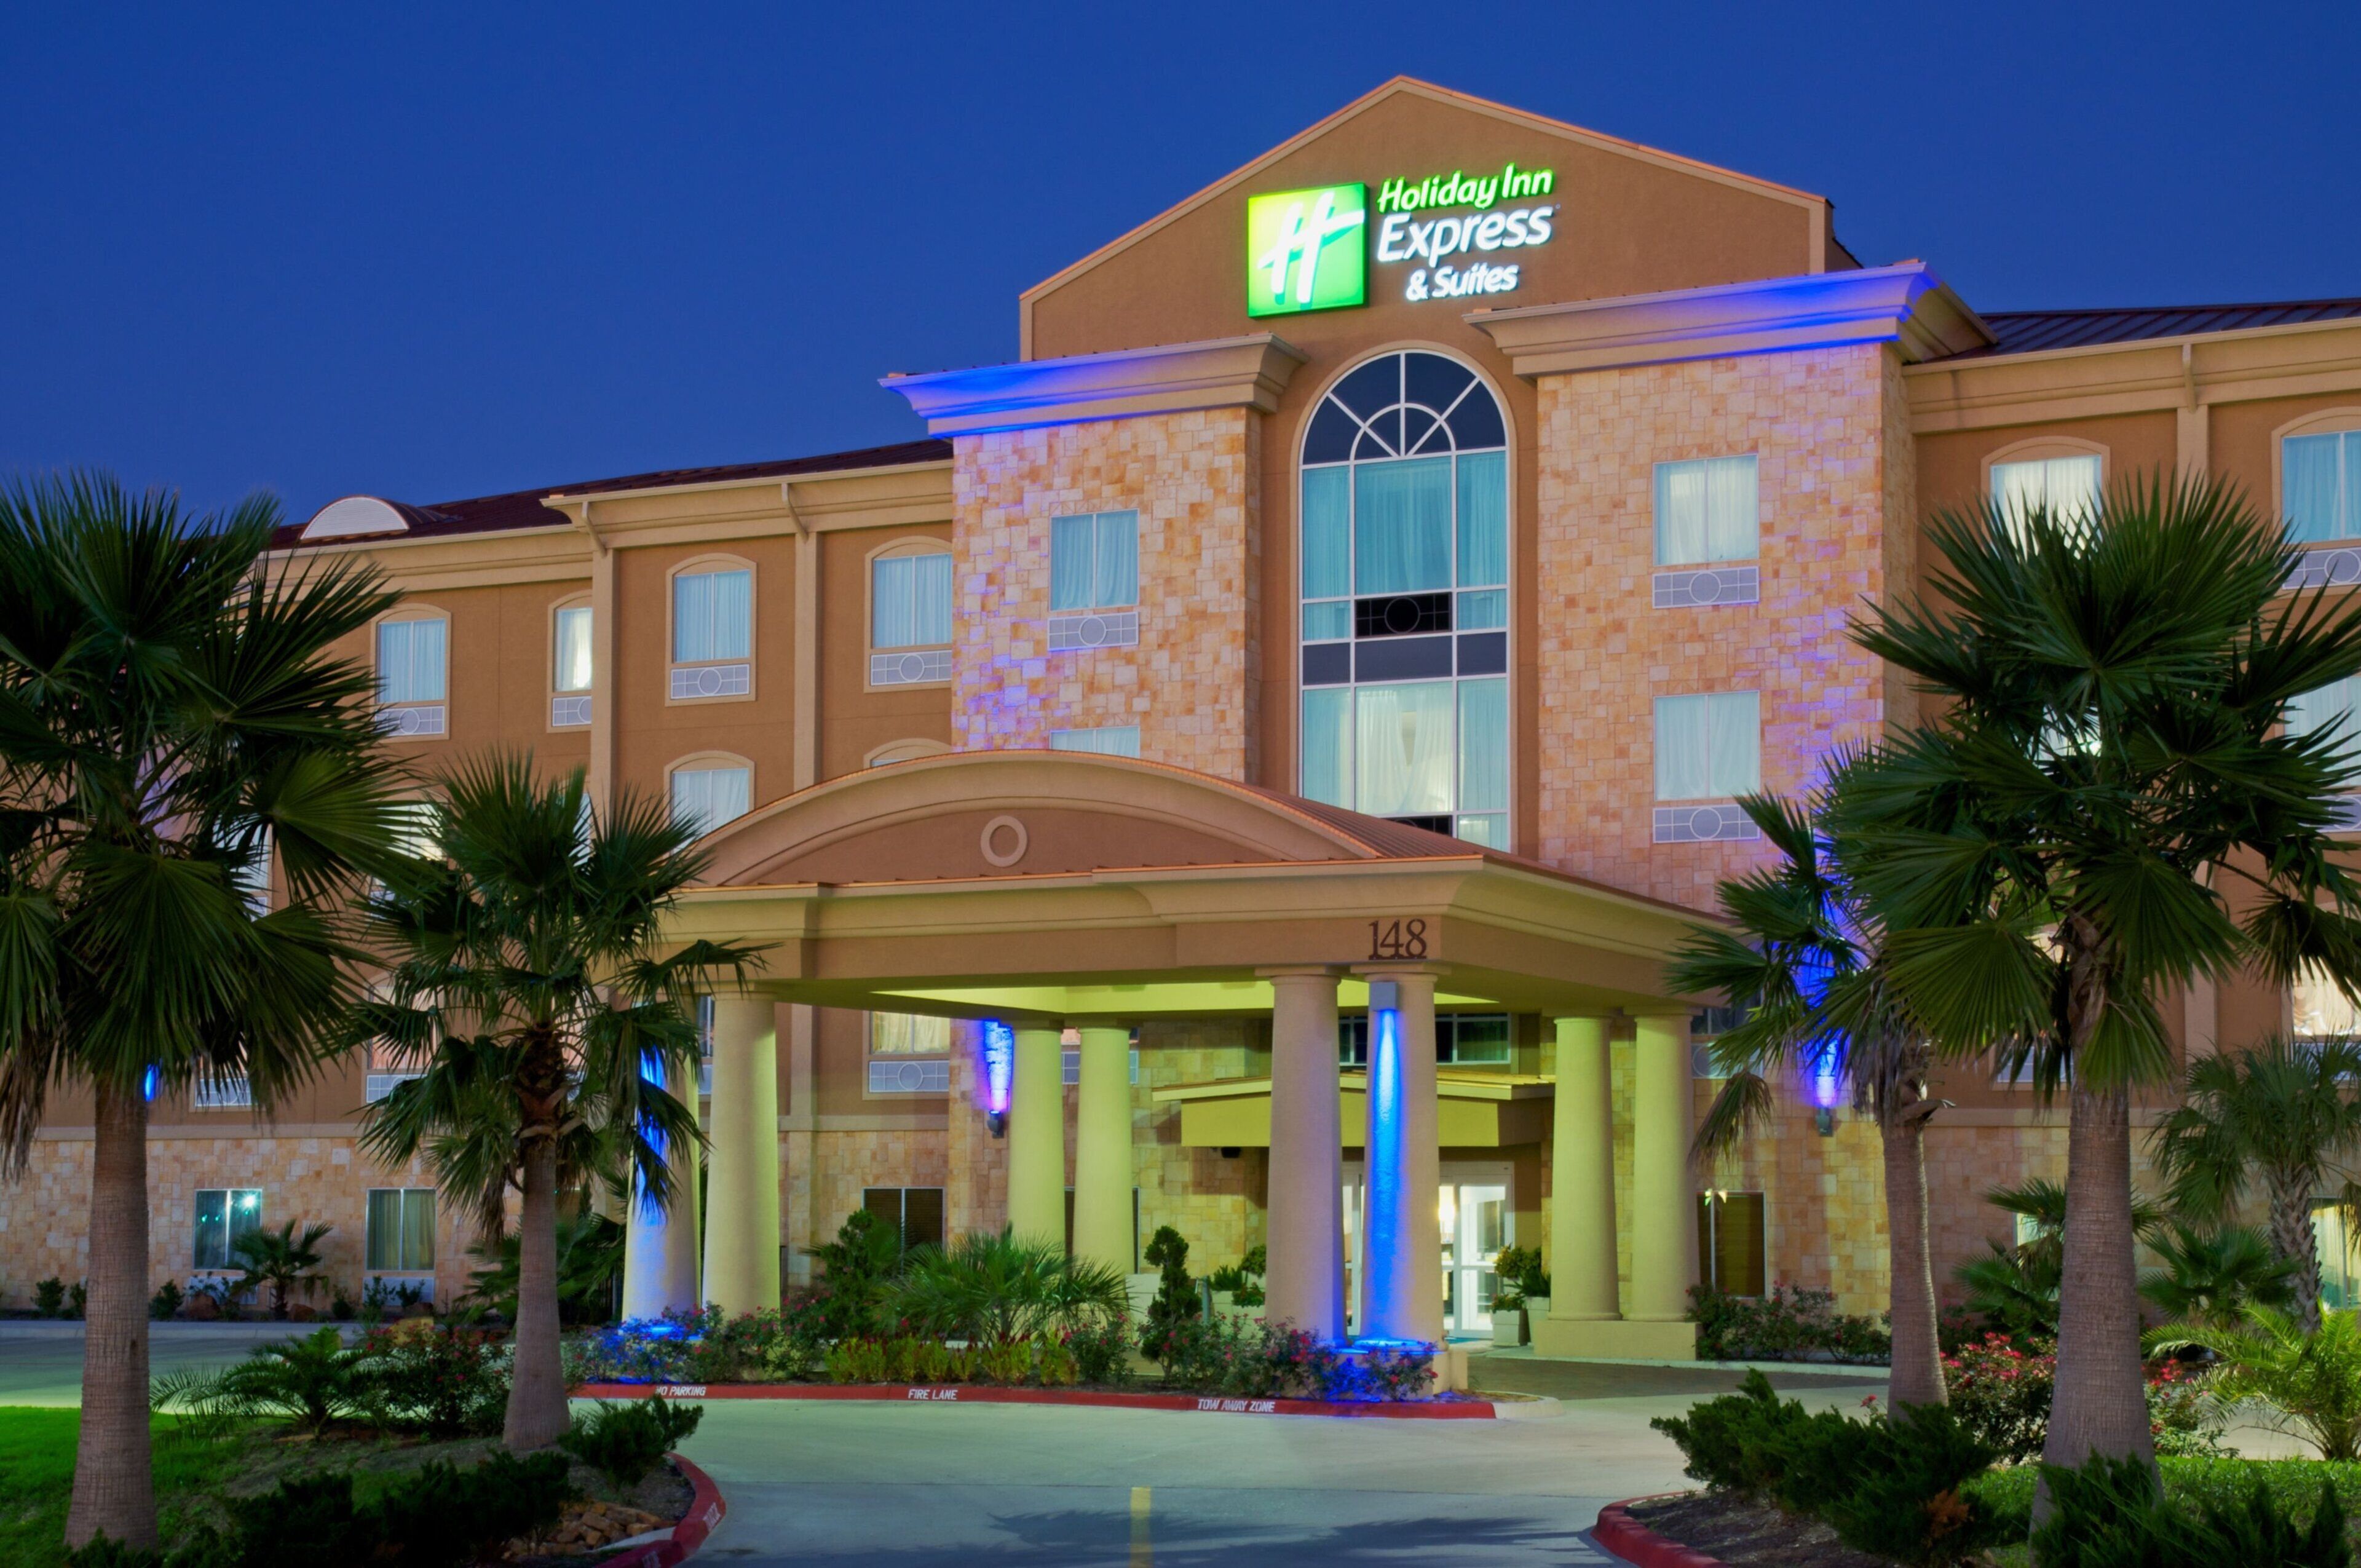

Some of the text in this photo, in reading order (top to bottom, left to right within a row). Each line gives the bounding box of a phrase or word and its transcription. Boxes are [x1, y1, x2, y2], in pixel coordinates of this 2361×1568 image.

[1377, 162, 1553, 213] Holiday Inn
[1377, 206, 1554, 267] Express
[1406, 263, 1519, 301] & Suites
[1369, 919, 1426, 960] 148
[669, 1386, 706, 1396] PARKING
[908, 1389, 958, 1400] FIRE LANE
[1198, 1399, 1276, 1412] TOW AWAY ZONE
